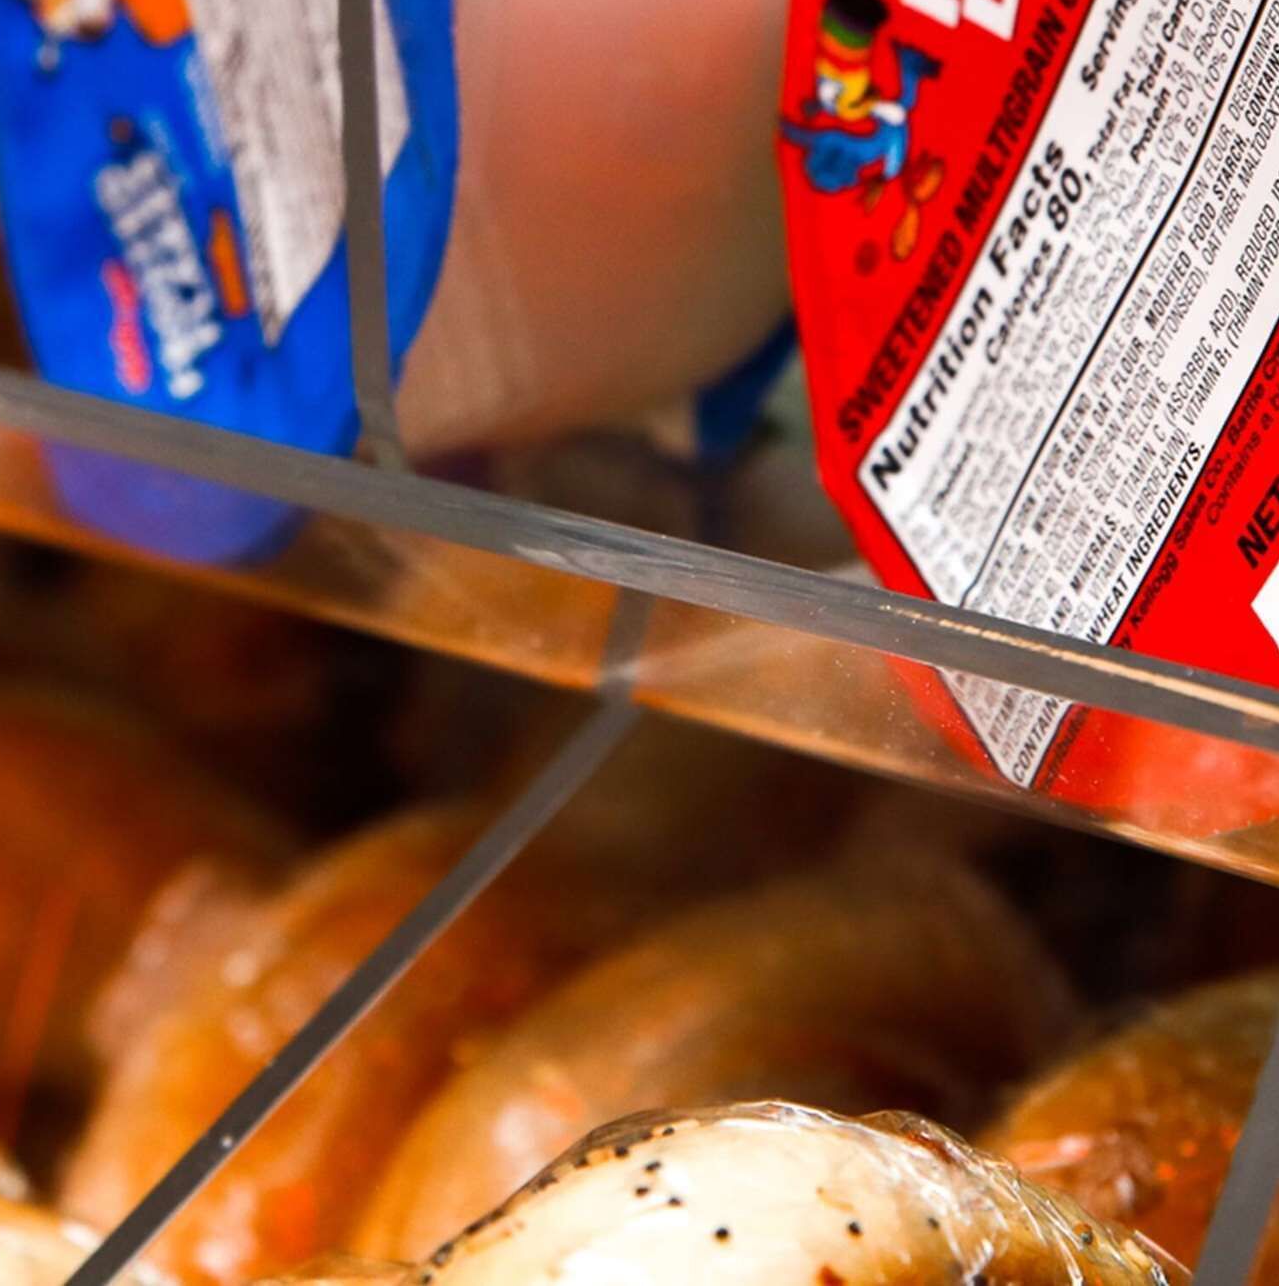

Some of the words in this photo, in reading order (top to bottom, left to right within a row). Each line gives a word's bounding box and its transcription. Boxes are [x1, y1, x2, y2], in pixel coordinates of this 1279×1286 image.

[1086, 108, 1119, 163] Total
[1112, 70, 1136, 110] Fat
[1129, 86, 1172, 165] Protein
[1175, 24, 1198, 53] Vit.
[1189, 0, 1205, 23] D
[1136, 42, 1168, 98] Total
[1155, 111, 1183, 160] (10%
[1174, 69, 1202, 111] DV),
[1200, 51, 1228, 102] (10%
[1219, 8, 1248, 51] DV).
[837, 230, 963, 443] SWEETENED
[954, 6, 1066, 233] MULTIGRAIN
[984, 238, 1053, 366] Calories
[1046, 167, 1093, 233] 80,
[1063, 427, 1095, 479] GRAIN
[1091, 391, 1113, 427] OAT
[1110, 335, 1150, 393] FLOUR,
[1144, 250, 1192, 331] MODIFIED
[1187, 201, 1217, 251] FOOD
[1212, 133, 1251, 202] STARCH,
[1120, 283, 1153, 336] GRAIN
[1145, 219, 1186, 284] YELLOW
[1181, 175, 1210, 224] CORN
[1202, 122, 1236, 179] FLOUR,
[1146, 265, 1210, 369] COTTONSEED),
[1201, 228, 1223, 266] OAT
[1215, 187, 1247, 237] FIBER,
[869, 286, 994, 492] Nutrition
[988, 140, 1065, 278] Facts
[1114, 441, 1157, 509] VITAMIN
[1152, 423, 1167, 443] C
[1164, 335, 1213, 427] (ASCORBIC
[1208, 287, 1242, 339] ACID),
[1234, 203, 1276, 283] REDUCED
[1182, 361, 1221, 426] VITAMIN
[1225, 271, 1265, 349] (THIAMIN
[1122, 387, 1162, 451] YELLOW
[1173, 492, 1207, 550] Sales
[1226, 382, 1265, 446] Battle
[1206, 430, 1262, 527] Contains
[1259, 411, 1274, 432] a
[1085, 573, 1129, 653] WHEAT
[1125, 441, 1206, 577] INGREDIENTS.
